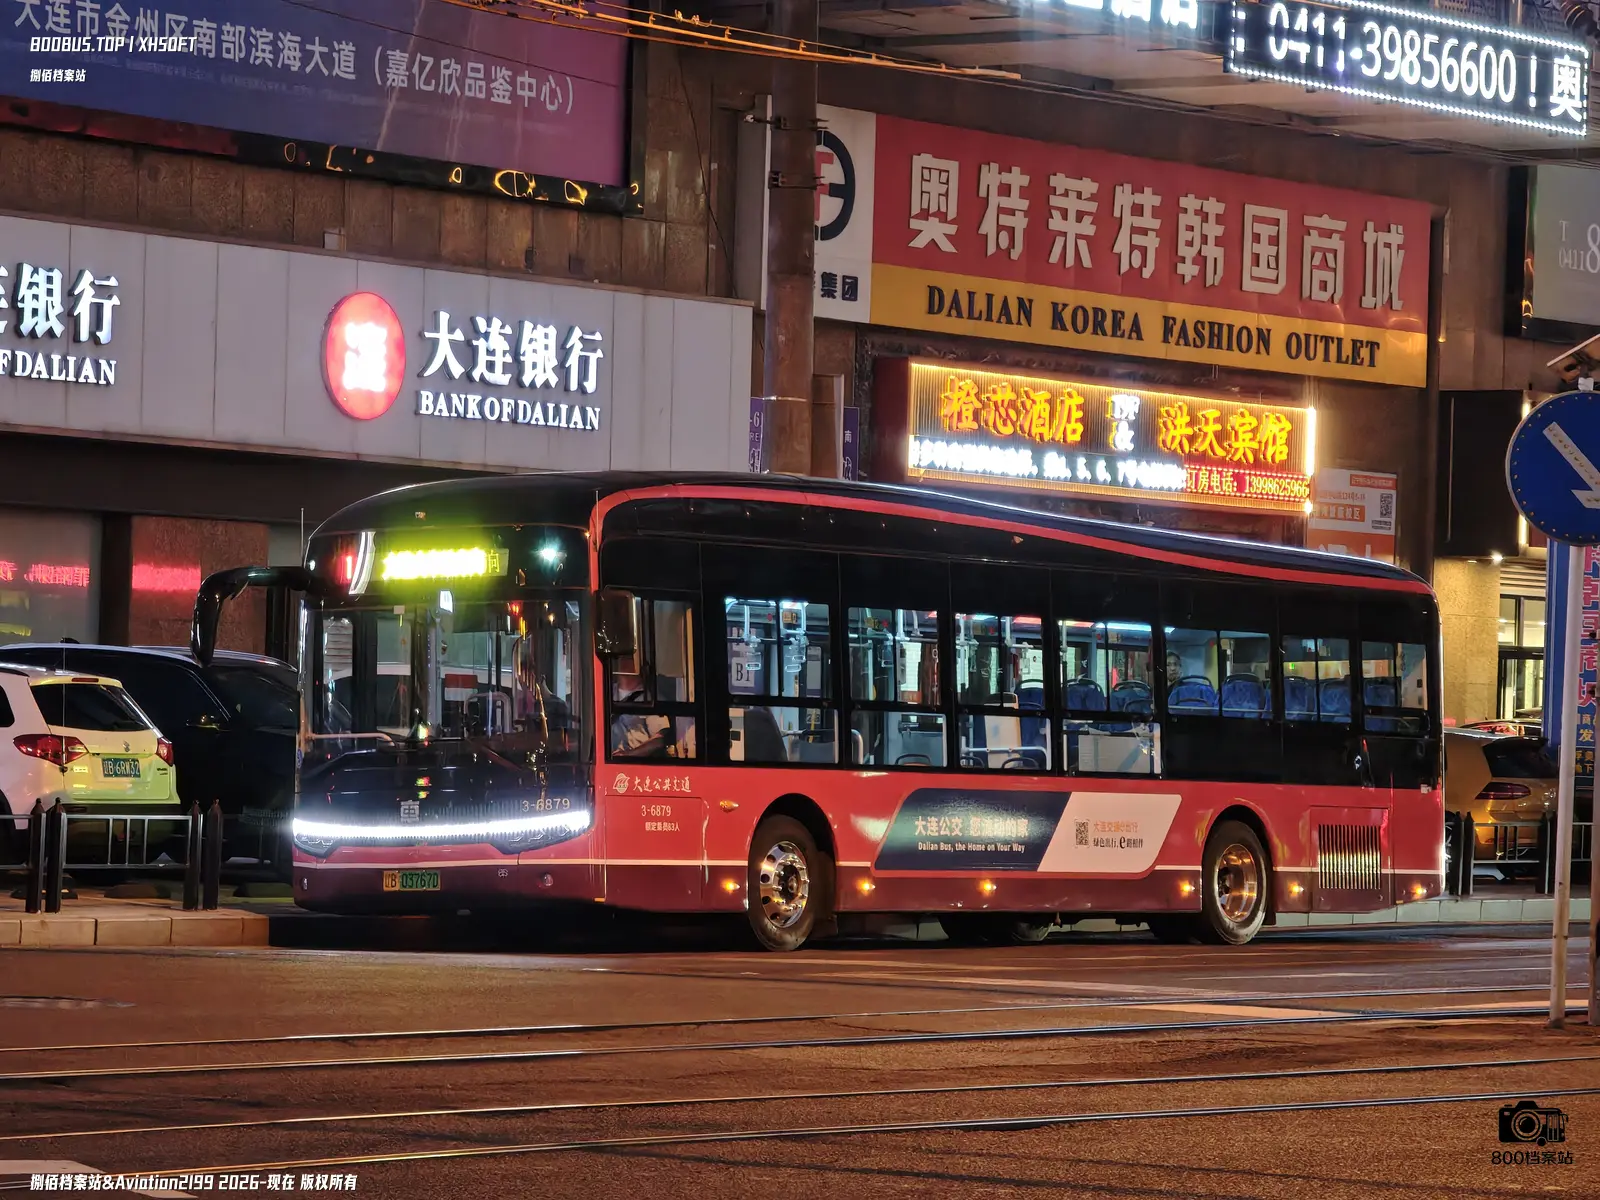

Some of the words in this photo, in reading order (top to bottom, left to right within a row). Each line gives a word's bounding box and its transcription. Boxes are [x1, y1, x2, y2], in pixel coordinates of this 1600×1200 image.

[908, 153, 1404, 311] 奥特莱特韩国商城
[814, 271, 858, 302] 集团
[0, 263, 120, 344] 银行
[927, 285, 1034, 327] DALIAN
[1050, 301, 1144, 341] KOREA
[1162, 315, 1272, 355] FASHION
[1285, 332, 1381, 368] OUTLET
[419, 310, 604, 394] 大连银行
[942, 375, 1085, 443] 橙芯酒店
[633, 775, 691, 793] 大连公共交通
[521, 797, 571, 812] 3-6879
[641, 804, 672, 817] 3-6879
[915, 815, 962, 836] 大连公交
[918, 841, 939, 851] Dalian
[940, 841, 954, 853] Bus,
[955, 842, 966, 851] the
[967, 842, 986, 851] Home
[986, 843, 995, 851] on
[996, 842, 1011, 852] Your
[1012, 842, 1026, 853] Way
